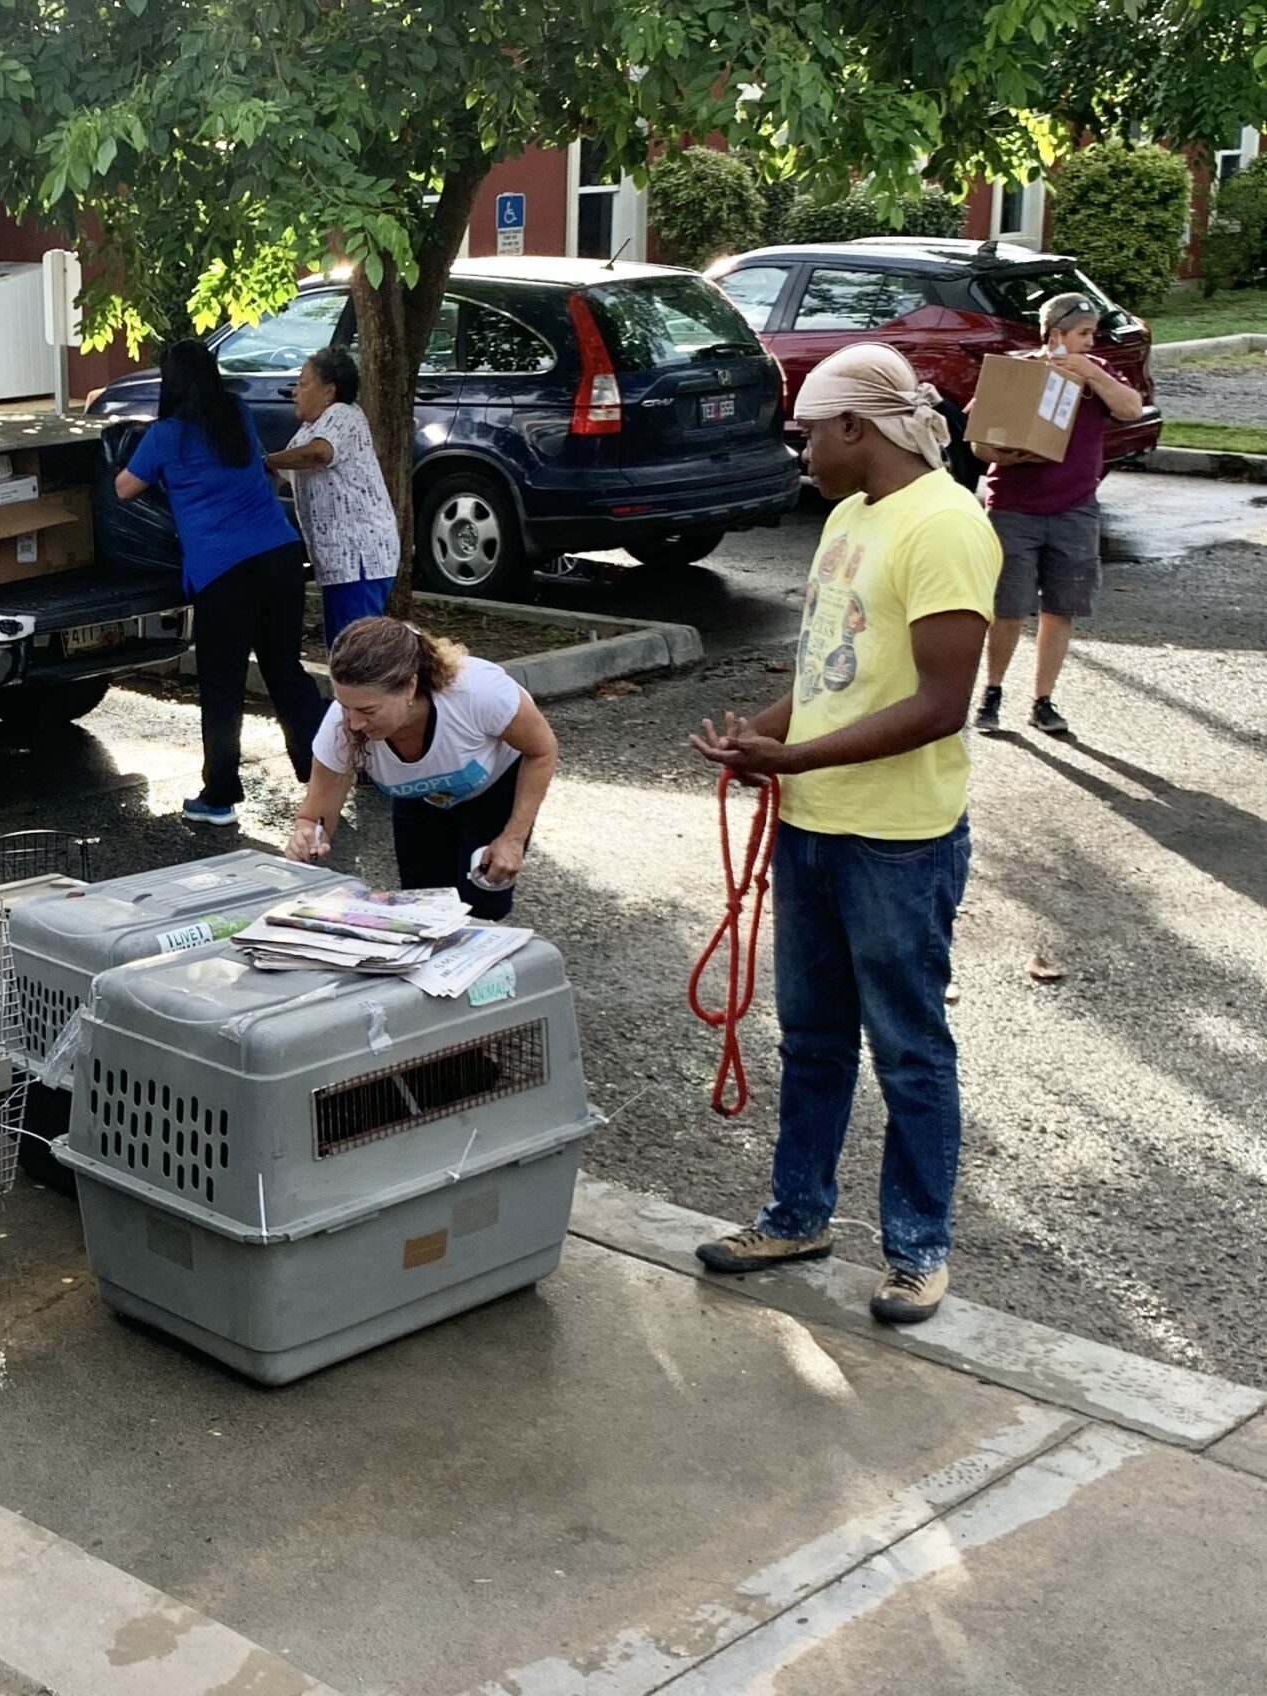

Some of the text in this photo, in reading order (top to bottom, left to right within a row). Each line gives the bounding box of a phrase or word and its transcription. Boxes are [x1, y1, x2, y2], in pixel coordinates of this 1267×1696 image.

[390, 775, 453, 796] ADOPT
[174, 928, 198, 947] LIVE
[470, 982, 509, 1002] ANIMAL
